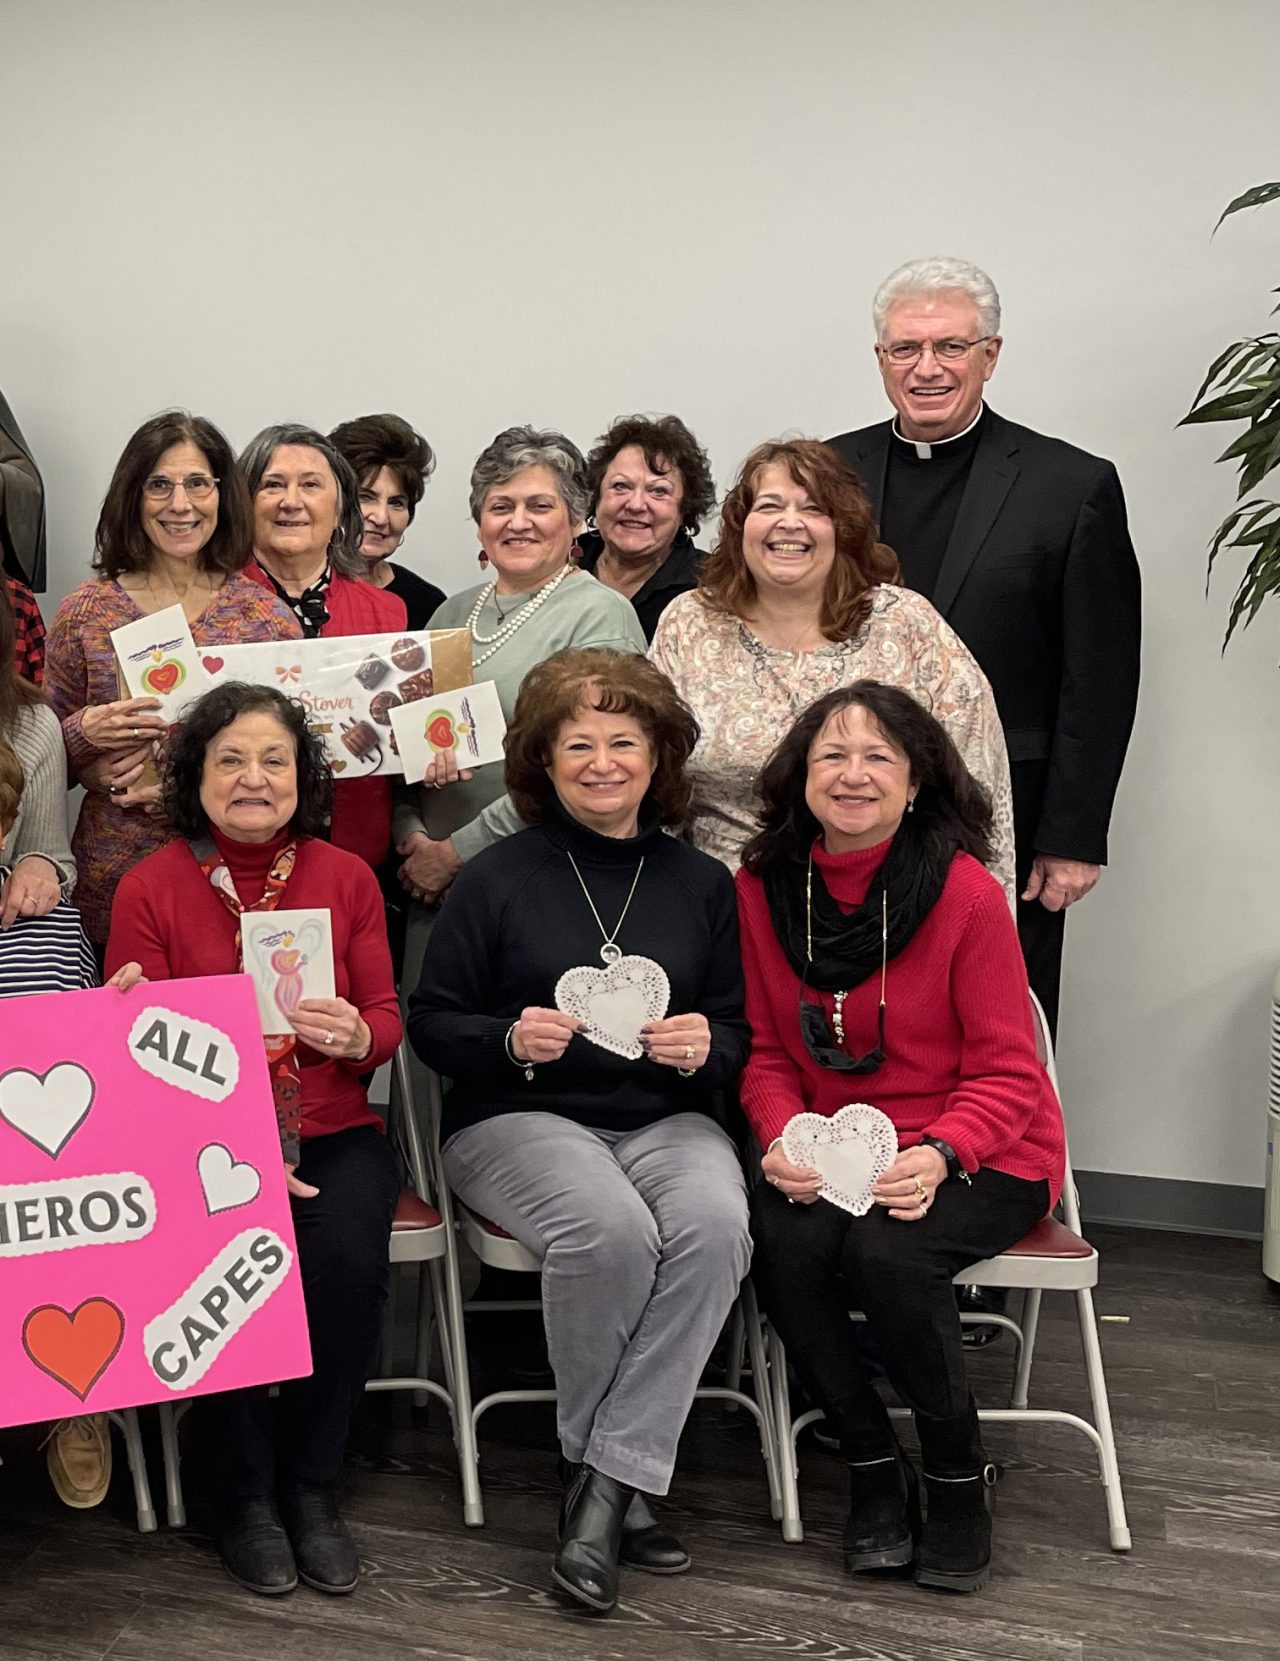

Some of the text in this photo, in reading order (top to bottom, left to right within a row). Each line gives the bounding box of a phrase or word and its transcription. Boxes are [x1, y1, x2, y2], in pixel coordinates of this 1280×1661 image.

[299, 690, 354, 713] Stover
[136, 1020, 225, 1085] ALL
[153, 1236, 283, 1382] CAPES
